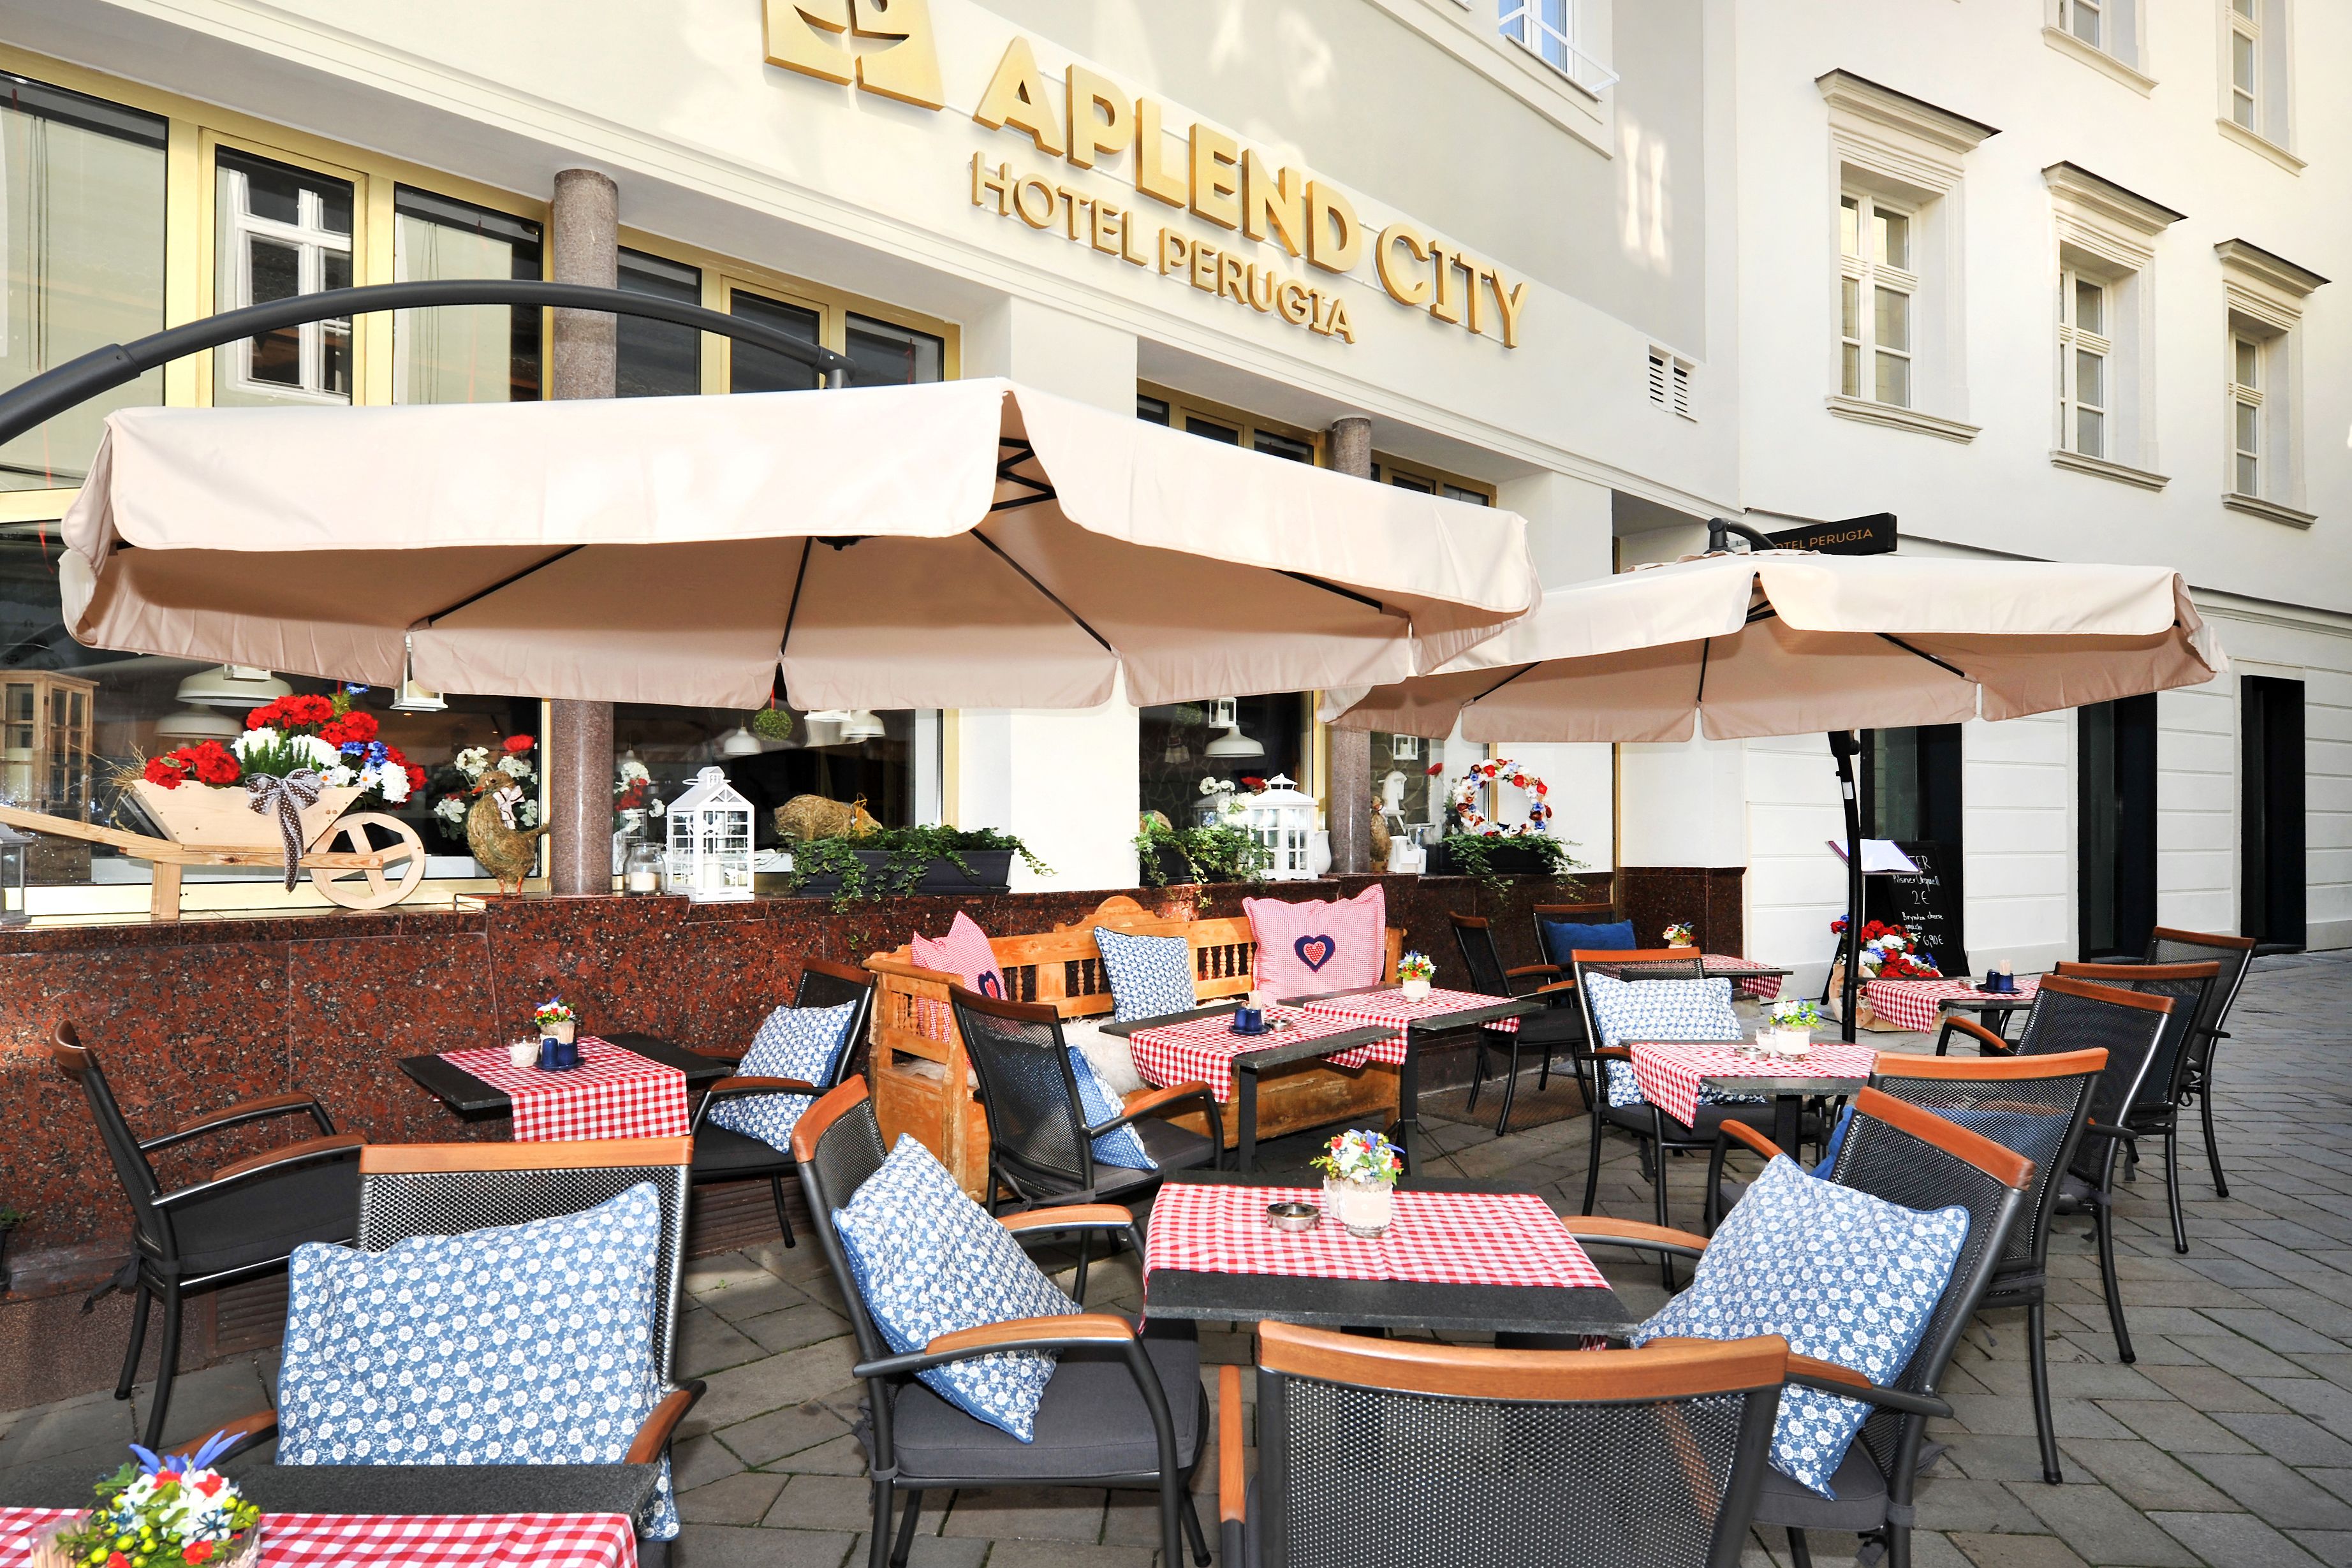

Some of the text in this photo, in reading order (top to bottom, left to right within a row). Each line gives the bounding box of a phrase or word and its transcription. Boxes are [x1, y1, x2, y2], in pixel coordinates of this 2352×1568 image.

[971, 36, 1528, 349] APLEND CITY
[971, 151, 1356, 344] HOTEL PERUGIA
[1775, 529, 1873, 550] OTEL PERUGIA
